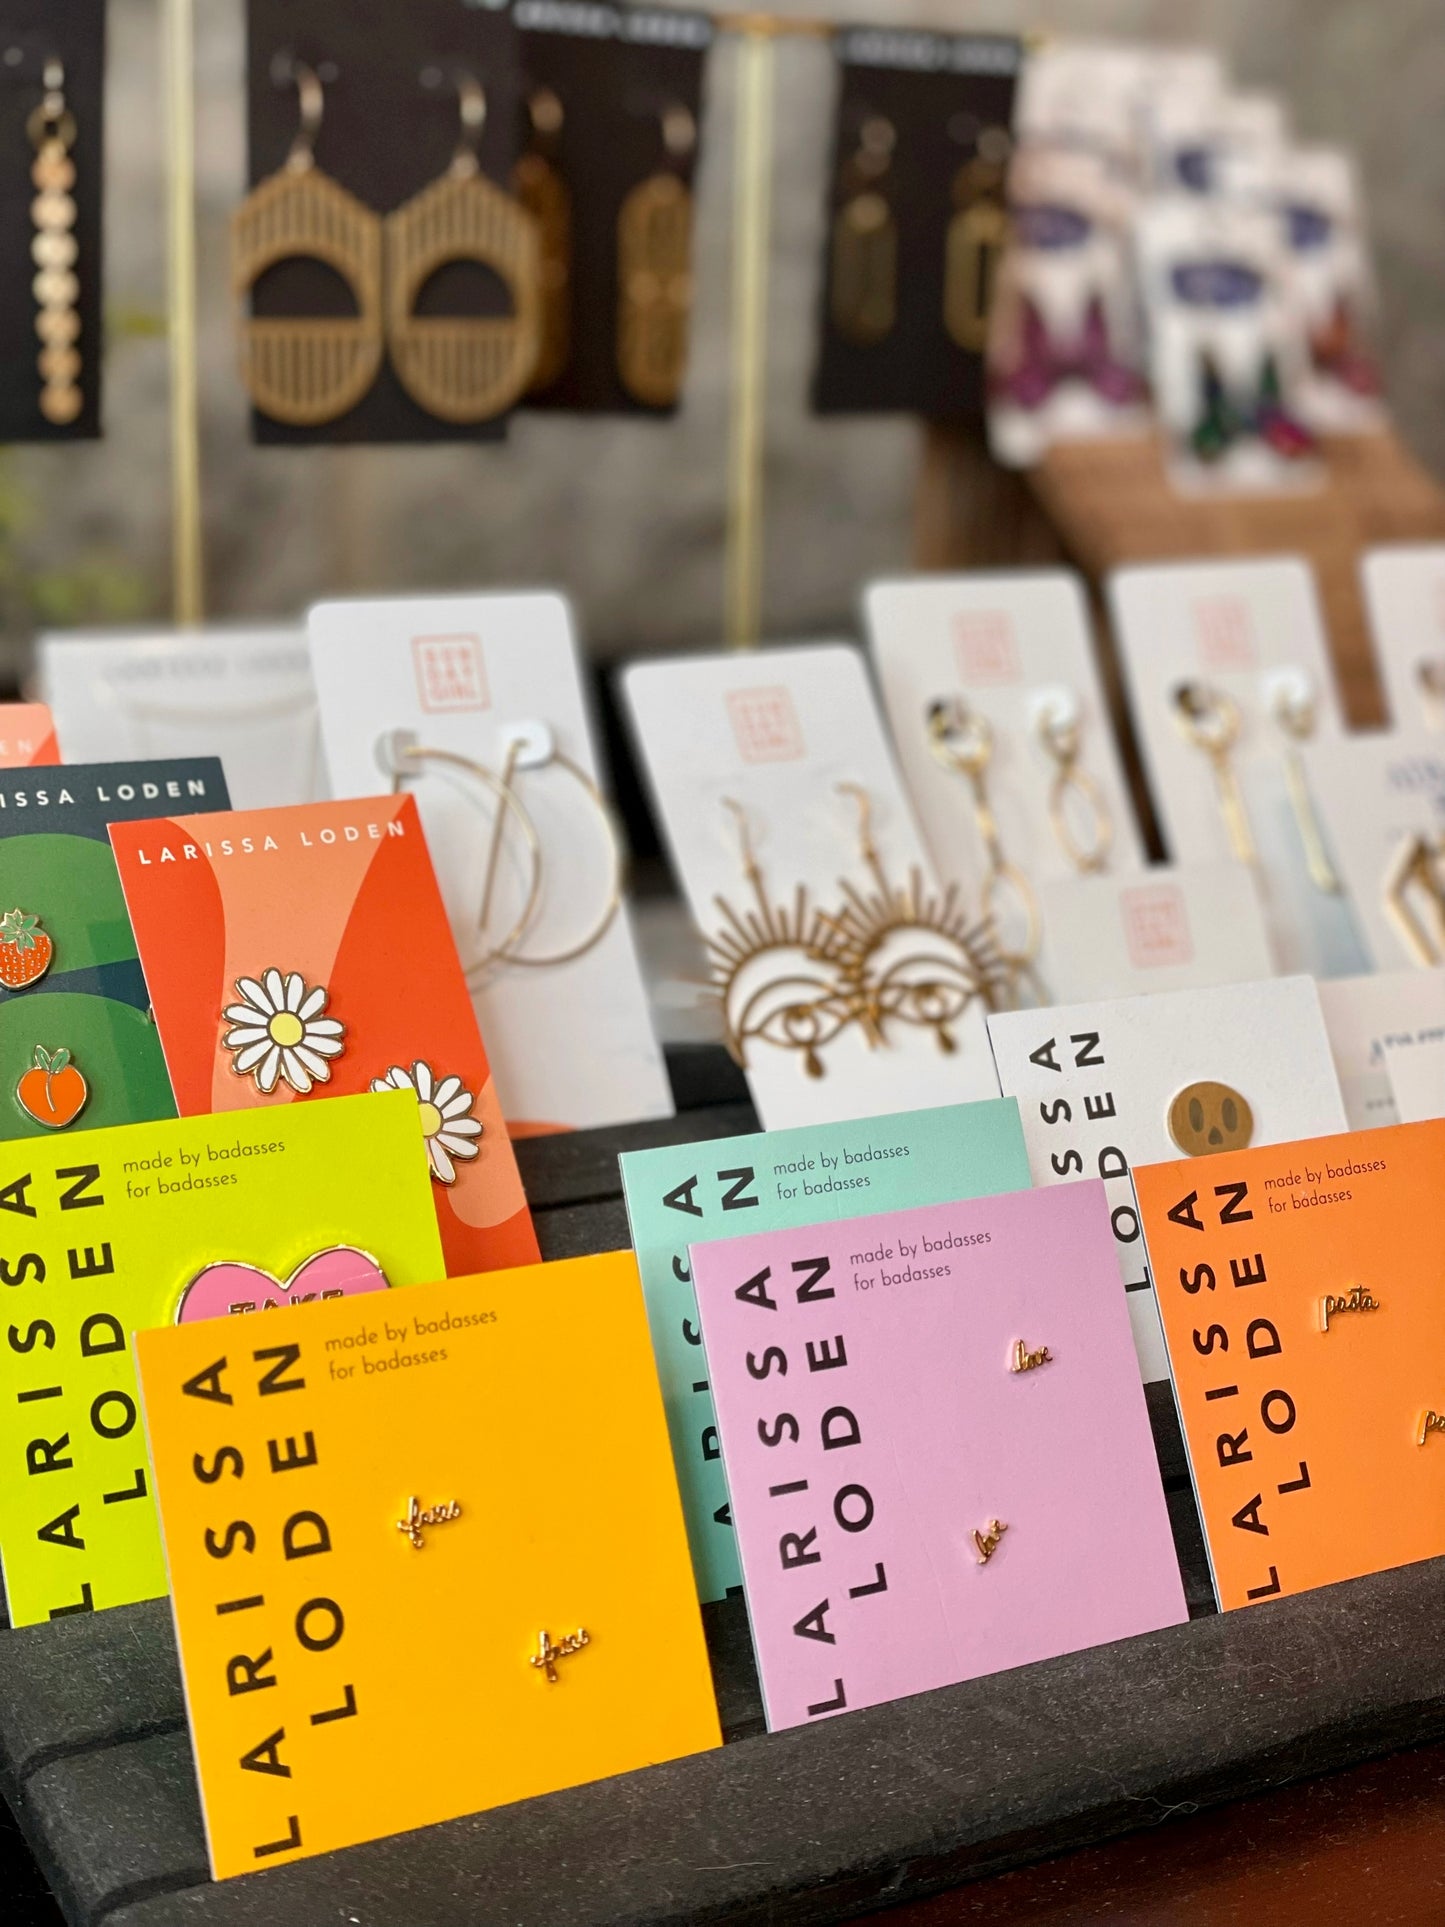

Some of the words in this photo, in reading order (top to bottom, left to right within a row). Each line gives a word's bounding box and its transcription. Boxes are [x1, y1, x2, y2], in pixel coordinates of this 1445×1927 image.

[97, 780, 205, 802] LODEN
[138, 835, 278, 865] LARISSA
[300, 820, 404, 846] LODEN
[123, 1151, 173, 1173] made
[180, 1148, 201, 1167] by
[207, 1140, 286, 1162] badasses
[773, 1154, 815, 1176] made
[820, 1151, 839, 1171] by
[843, 1144, 910, 1165] badasses
[1070, 1031, 1151, 1293] LODEN
[1264, 1168, 1301, 1190] made
[1305, 1166, 1322, 1184] by
[1326, 1158, 1387, 1178] badasses
[127, 1180, 151, 1199] for
[158, 1172, 238, 1195] badasses
[777, 1183, 798, 1201] for
[804, 1174, 871, 1196] badasses
[1268, 1196, 1287, 1213] for
[1293, 1187, 1353, 1210] badasses
[850, 1242, 893, 1266] made
[899, 1239, 917, 1260] by
[922, 1231, 992, 1253] badasses
[854, 1273, 876, 1292] for
[881, 1263, 951, 1287] badasses
[1319, 1284, 1380, 1333] pasta
[55, 1163, 147, 1505] LODEN
[325, 1327, 378, 1353] made
[384, 1322, 407, 1344] by
[414, 1309, 498, 1336] badasses
[1214, 1181, 1311, 1494] LODEN
[329, 1360, 355, 1382] for
[362, 1348, 449, 1376] badasses
[0, 1172, 94, 1620] LARISSA
[1167, 1189, 1281, 1600] LARISSA
[791, 1256, 887, 1599] LODEN
[734, 1266, 848, 1717] LARISSA
[253, 1342, 357, 1726] LODEN
[181, 1356, 303, 1858] LARISSA
